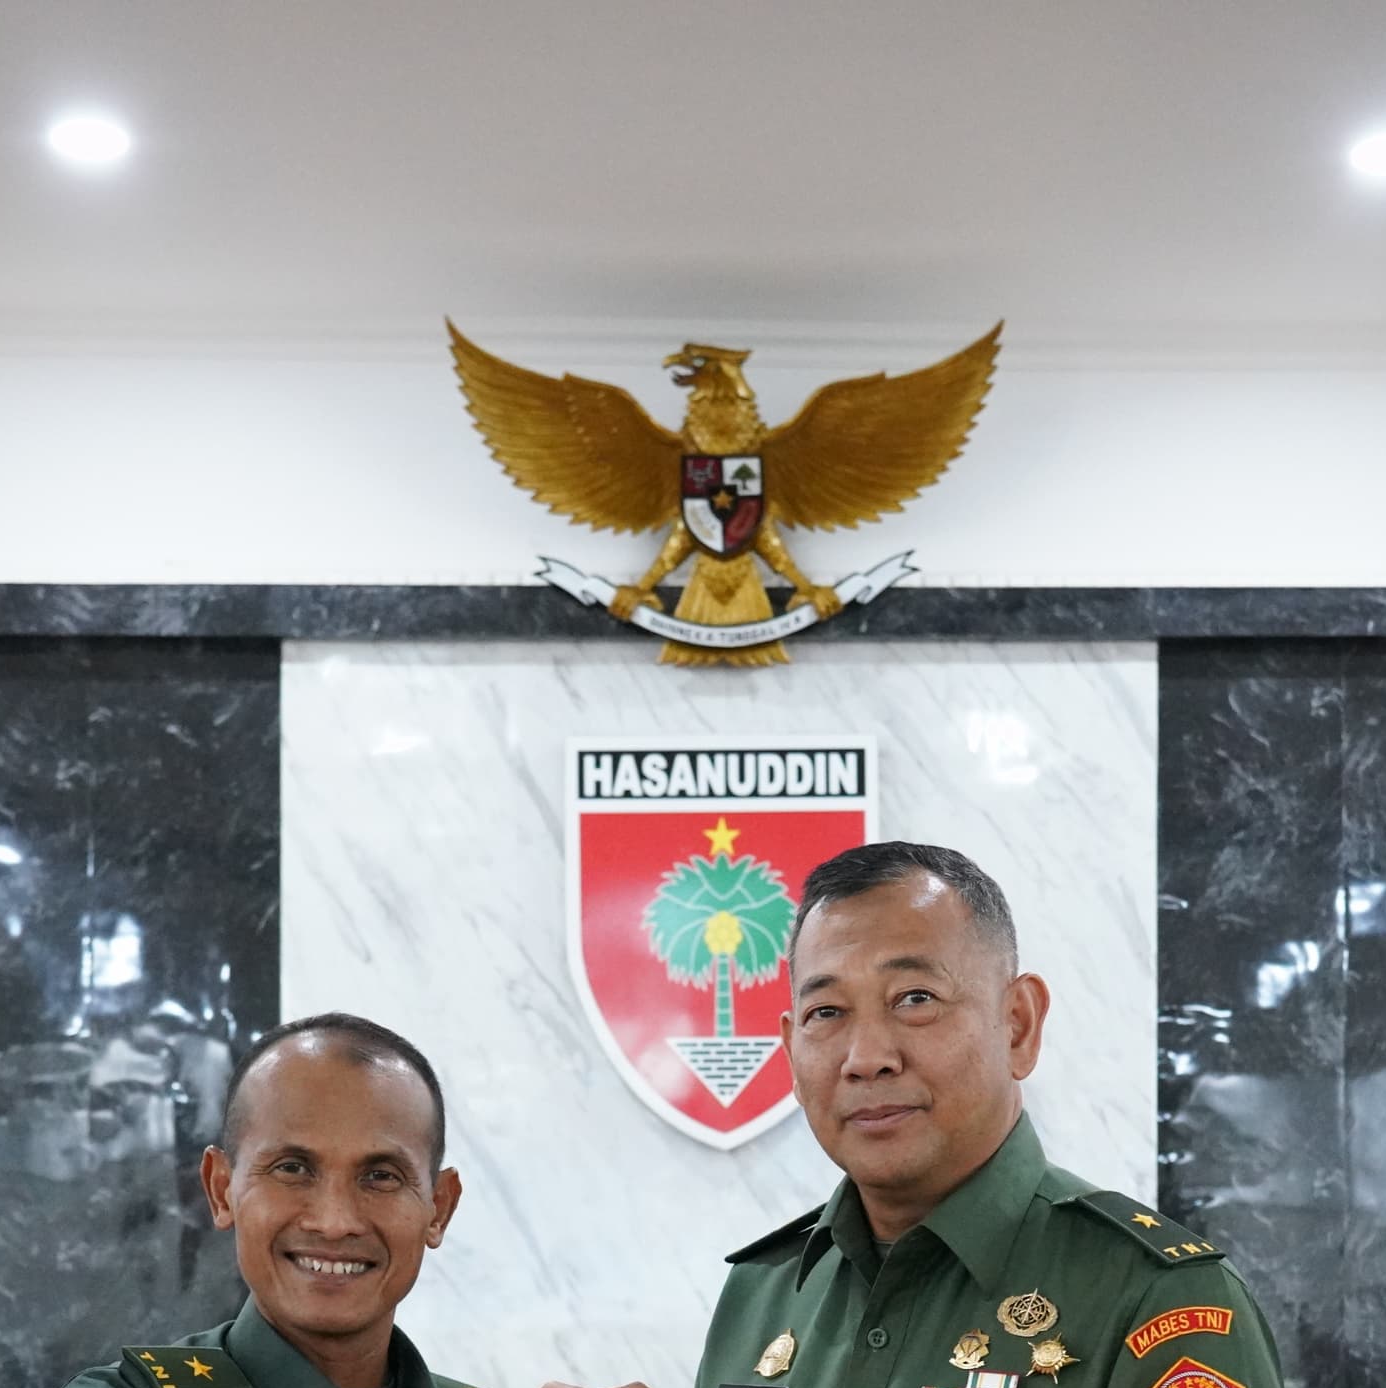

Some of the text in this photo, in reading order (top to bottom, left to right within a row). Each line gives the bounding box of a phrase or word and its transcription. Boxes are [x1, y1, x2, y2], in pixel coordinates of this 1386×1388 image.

[582, 752, 859, 797] HASANUDDIN
[1162, 1241, 1215, 1258] TNI
[1135, 1311, 1223, 1351] MABES TNI
